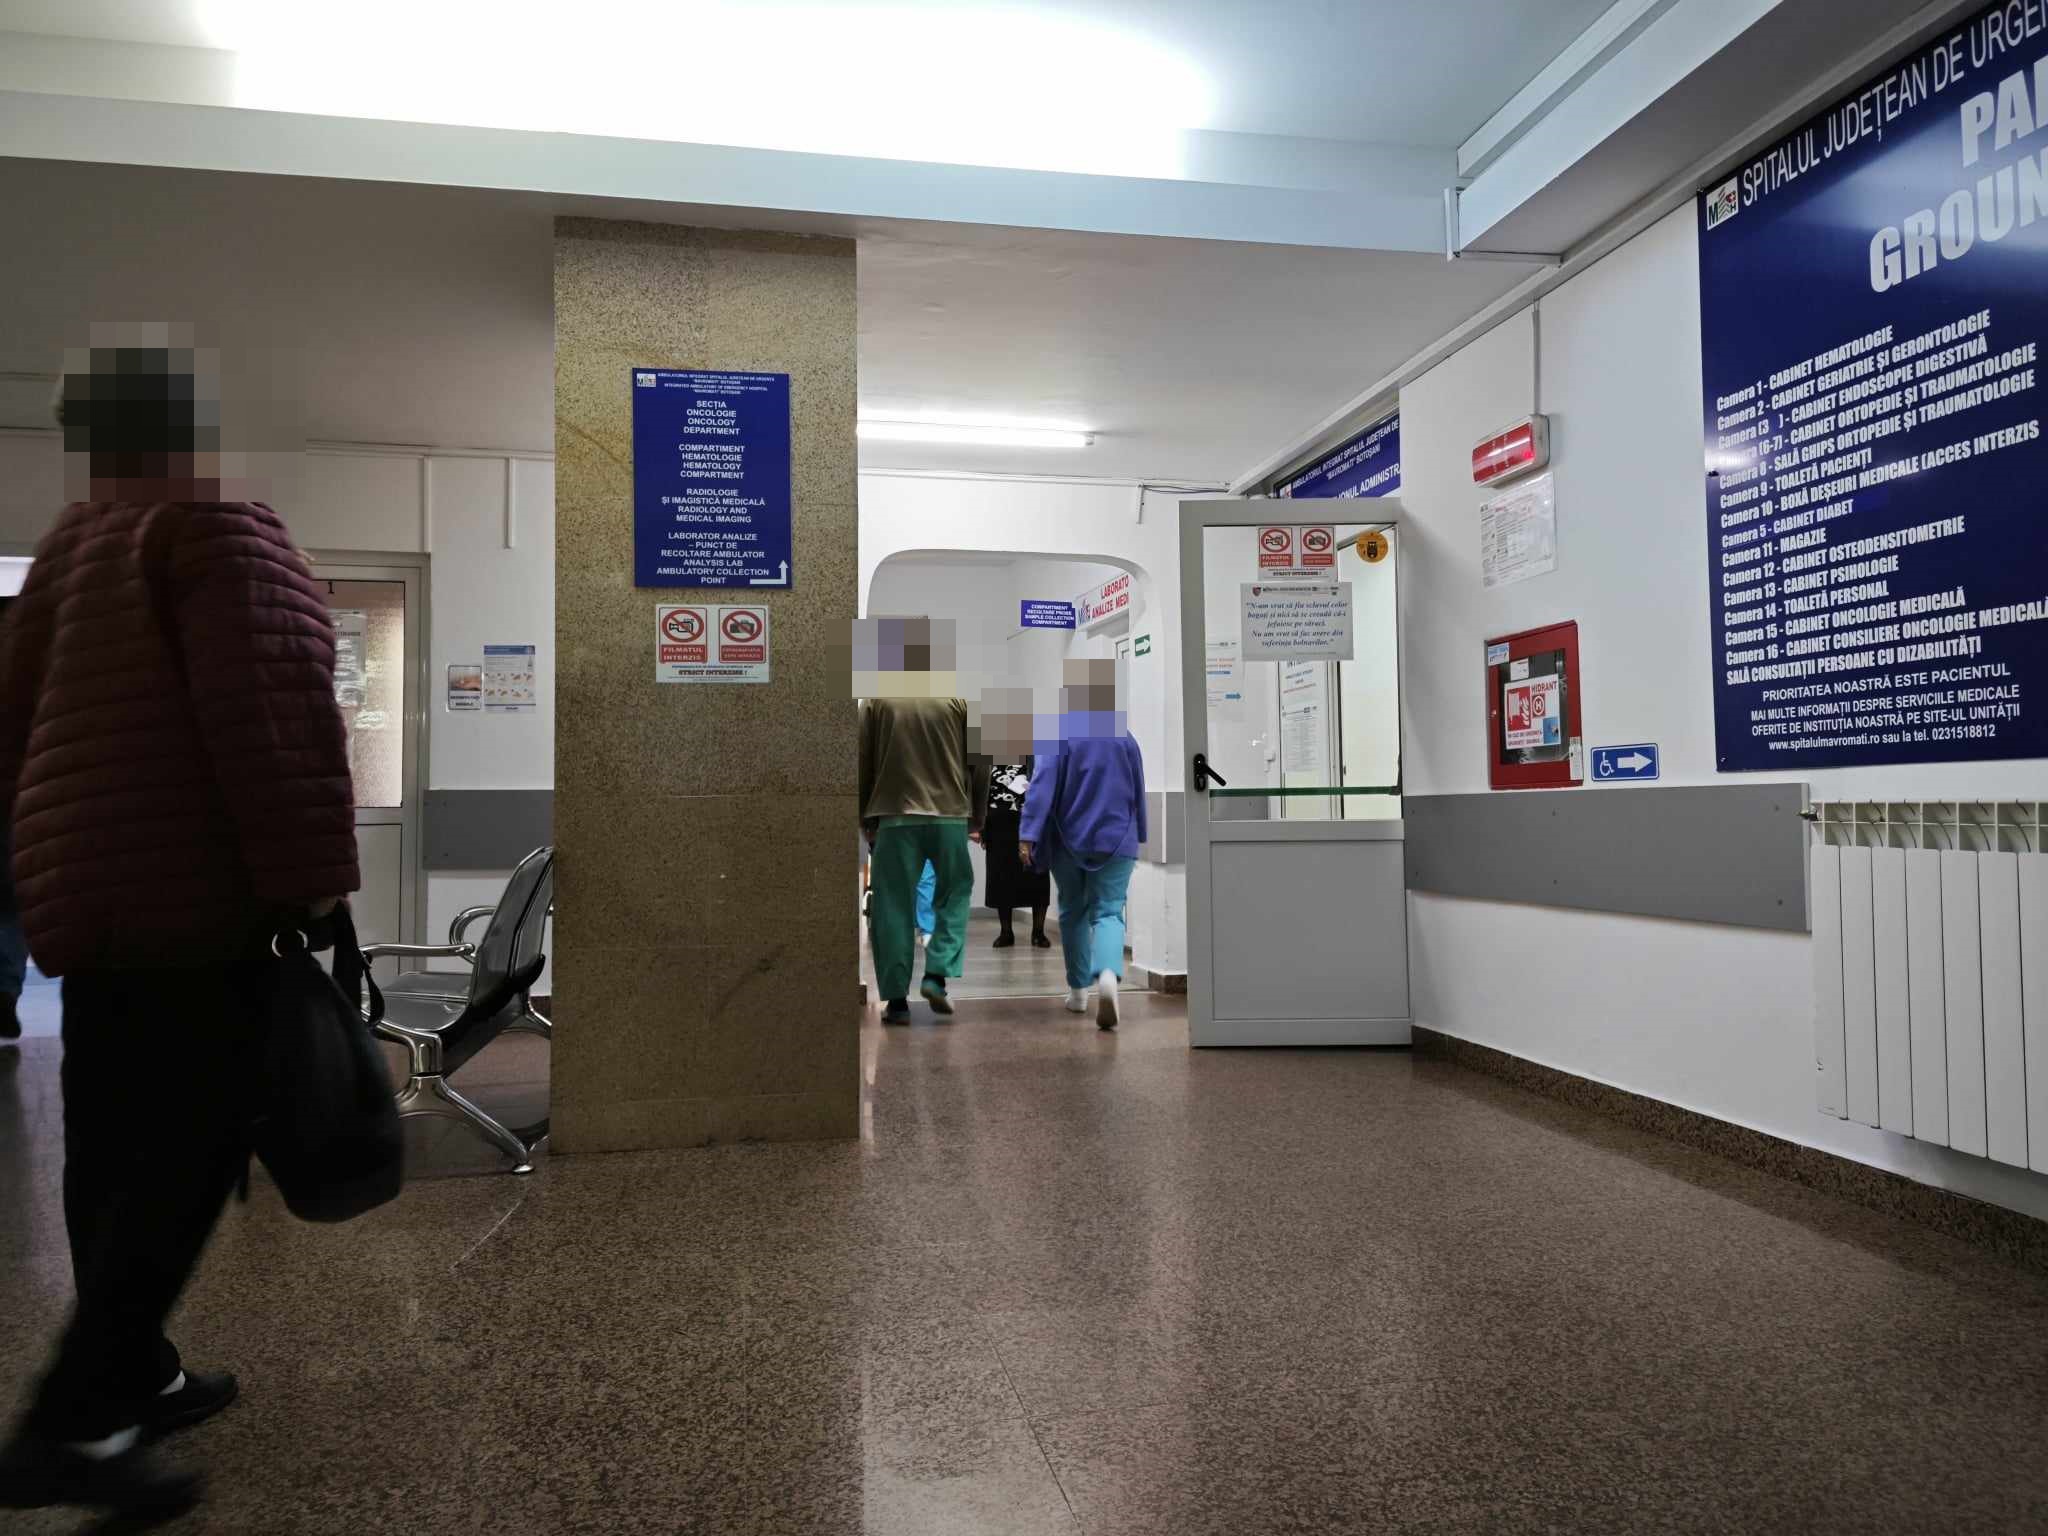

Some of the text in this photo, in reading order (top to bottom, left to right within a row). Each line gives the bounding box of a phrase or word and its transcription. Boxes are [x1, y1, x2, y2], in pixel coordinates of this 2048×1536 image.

[1743, 129, 1820, 206] SPITALUL
[1824, 57, 1927, 158] JUDEȚEAN
[1933, 33, 1965, 93] DE
[1716, 325, 1893, 412] Camera 1 CABINET HEMATOLOGIE
[1717, 309, 1990, 431] Camera 2 CABINET GERIATRIE ȘI GERONTOLOGIE
[696, 400, 727, 409] SECȚIA
[1718, 426, 1757, 450] Camera
[1791, 392, 1837, 424] CABINET
[1838, 363, 1914, 406] ENDOSCOPIE
[1915, 332, 1988, 378] DIGESTIVĂ
[1790, 414, 1836, 445] CABINET
[1837, 391, 1903, 428] ORTOPEDIE
[1904, 385, 1918, 409] ȘI
[1919, 342, 2036, 399] TRAUMATOLOGIE
[686, 409, 737, 417] ONCOLOGIE
[687, 418, 736, 426] ONCOLOGY
[683, 426, 740, 435] DEPARTMENT
[1719, 465, 1758, 490] Camera
[1774, 447, 1800, 471] SALĂ
[1801, 437, 1836, 462] GHIPS
[1836, 414, 1902, 451] ORTOPEDIE
[1903, 409, 1917, 432] ȘI
[1918, 369, 2035, 423] TRAUMATOLOGIE
[678, 444, 745, 453] COMPARTIMENT
[682, 453, 742, 461] HEMATOLOGIE
[680, 471, 744, 479] COMPARTMENT
[683, 462, 741, 470] HEMATOLOGY
[1720, 447, 1872, 509] Camera 9 TOALETĂ PACIENȚI
[1721, 506, 1760, 529] Camera
[1760, 500, 1773, 517] 10
[1780, 486, 1809, 511] BOXĂ
[1810, 474, 1857, 503] DEȘEURI
[1859, 455, 1920, 489] MEDICALE
[1973, 419, 2039, 455] INTERZIS
[686, 488, 738, 496] RADIOLOGIE
[678, 506, 727, 514] RADIOLOGY
[715, 515, 751, 523] IMAGING
[1721, 498, 1854, 548] Camera 5 CABINET DIABET
[668, 532, 758, 541] LABORATOR ANALIZE
[695, 541, 723, 549] PUNCT
[1722, 527, 1827, 568] Camera 11 MAGAZIE
[1723, 515, 1965, 587] Camera 12 CABINET OSTEODENSITOMETRIE
[683, 559, 724, 567] ANALYSIS
[712, 550, 765, 558] AMBULATOR
[656, 567, 769, 576] AMBULATORY COLLECTION
[1723, 554, 1899, 607] Camera 13 CABINET PSIHOLOGIE
[1092, 600, 1113, 618] ANALIZE
[1724, 580, 1889, 627] Camera 14 TOALETĂ PERSONAL
[1725, 586, 1966, 646] Camera 15 CABINET ONCOLOGIE MEDICALĂ
[1726, 648, 1765, 666] Camera
[1765, 643, 1779, 660] 16
[1786, 635, 1831, 657] CABINET
[1833, 624, 1901, 650] CONSILIERE
[1902, 611, 1976, 639] ONCOLOGIE
[1726, 634, 1982, 685] SALĂ CONSULTAȚII PERSOANE CU DIZABILITĂȚI
[1531, 680, 1557, 694] HIDRANT
[1763, 663, 2009, 702] PRIORITATEA NOASTRĂ ESTE PACIENTUL
[1751, 684, 2020, 721] MAI MULTE INFORMAȚII DESPRE SERVICIILE MEDICALE
[1752, 701, 2020, 736] OFERITE DE INSTITUȚIA NOASTRĂ PE SITE-UL UNITĂȚII
[1768, 724, 1996, 752] www.spitalulmavromati.ro sau la tel. 0231518812
